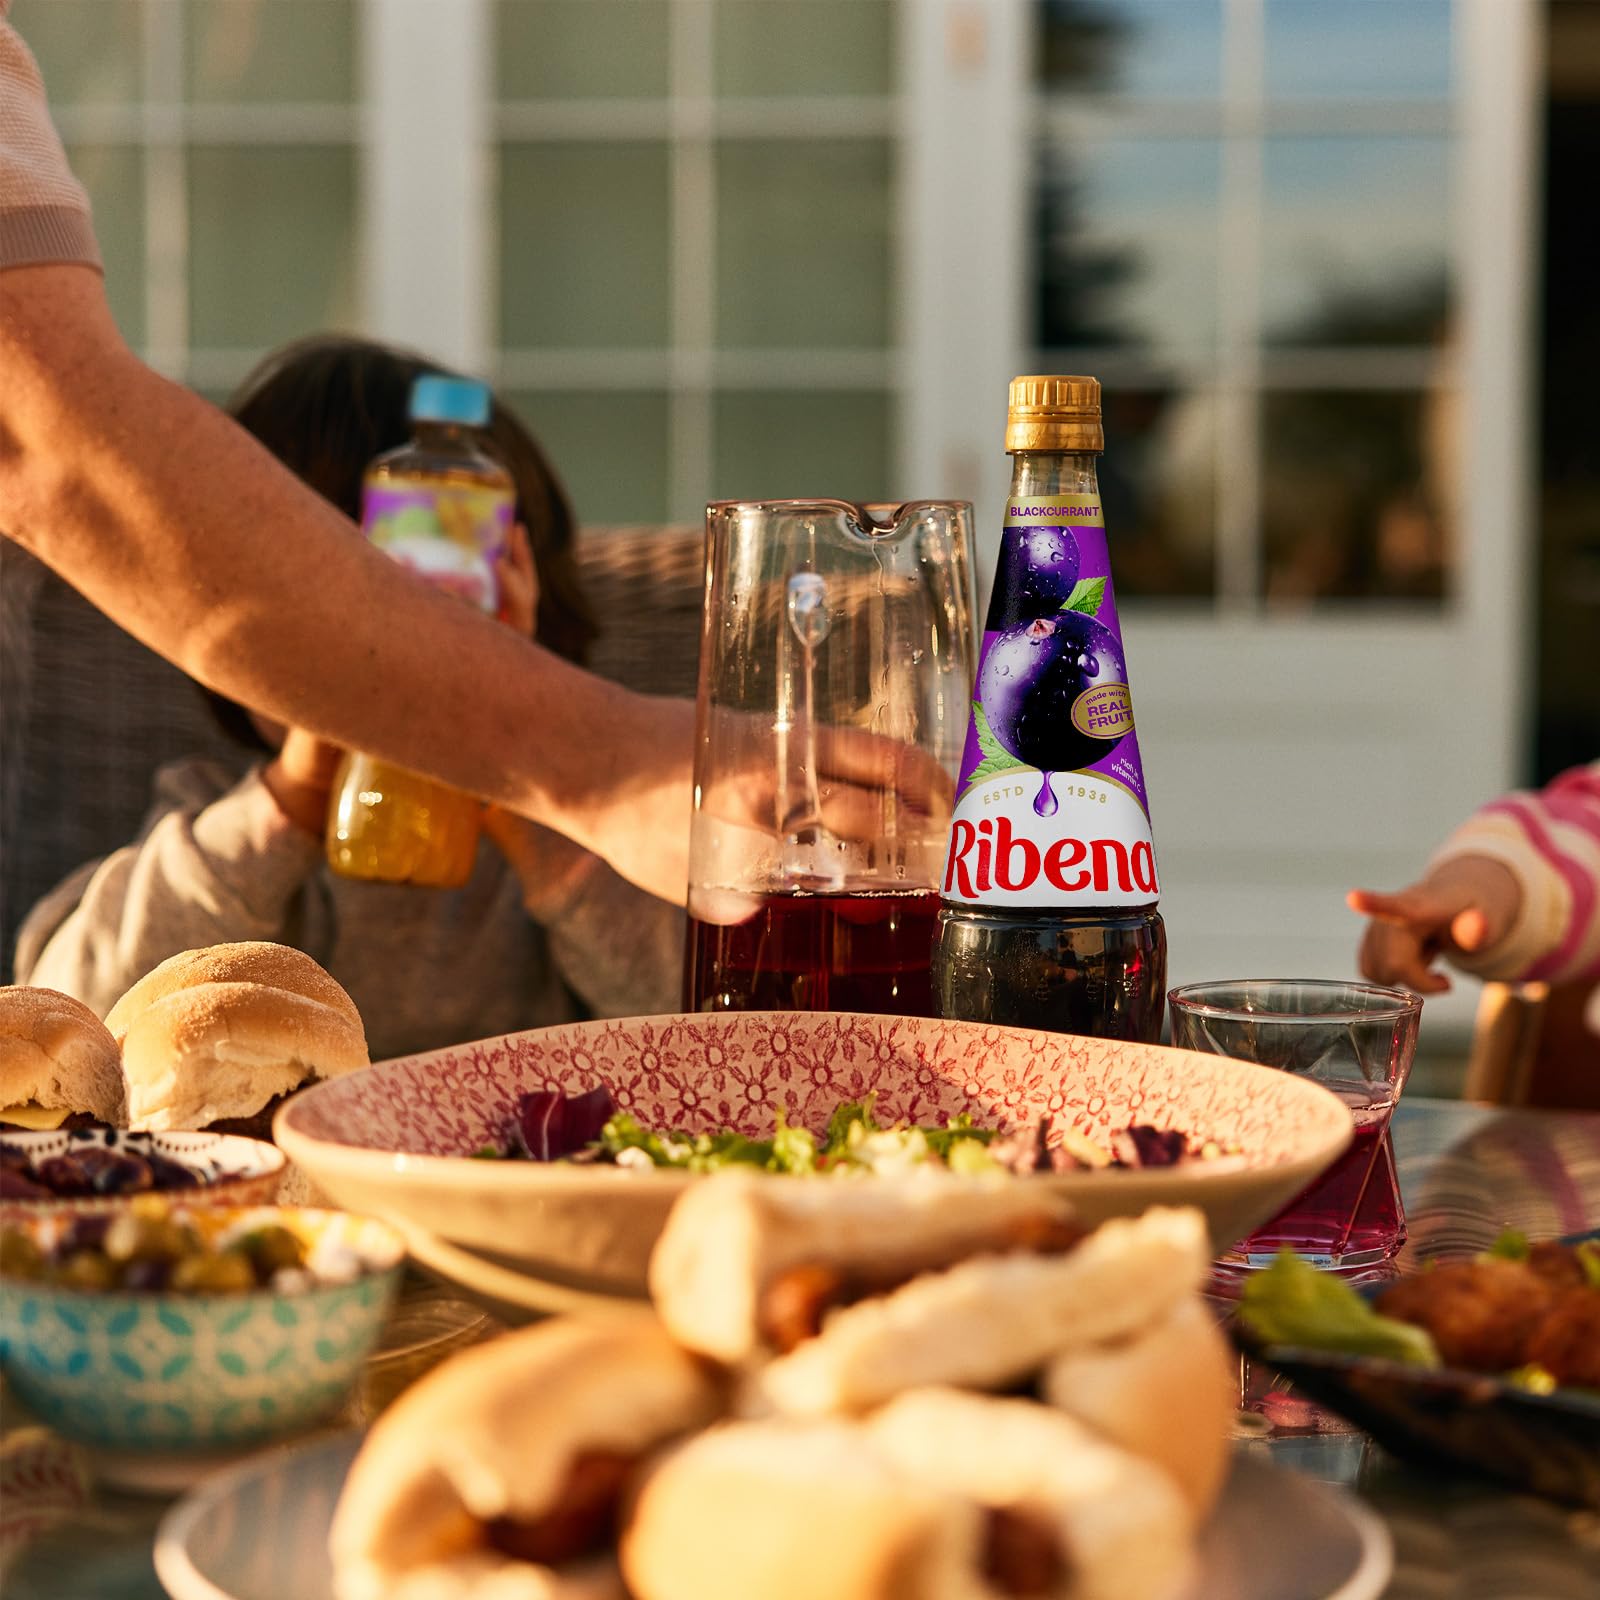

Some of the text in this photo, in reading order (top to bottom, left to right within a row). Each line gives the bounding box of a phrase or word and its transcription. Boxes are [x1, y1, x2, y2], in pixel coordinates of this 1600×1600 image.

[1010, 506, 1100, 517] BLACKCURRANT
[1085, 690, 1126, 705] made with
[1087, 699, 1129, 717] REAL
[1088, 709, 1133, 730] FRUIT
[1111, 763, 1137, 787] vitamin
[1120, 757, 1134, 774] rich
[983, 785, 1107, 805] ESTD 1938
[944, 816, 1159, 899] Ribena
